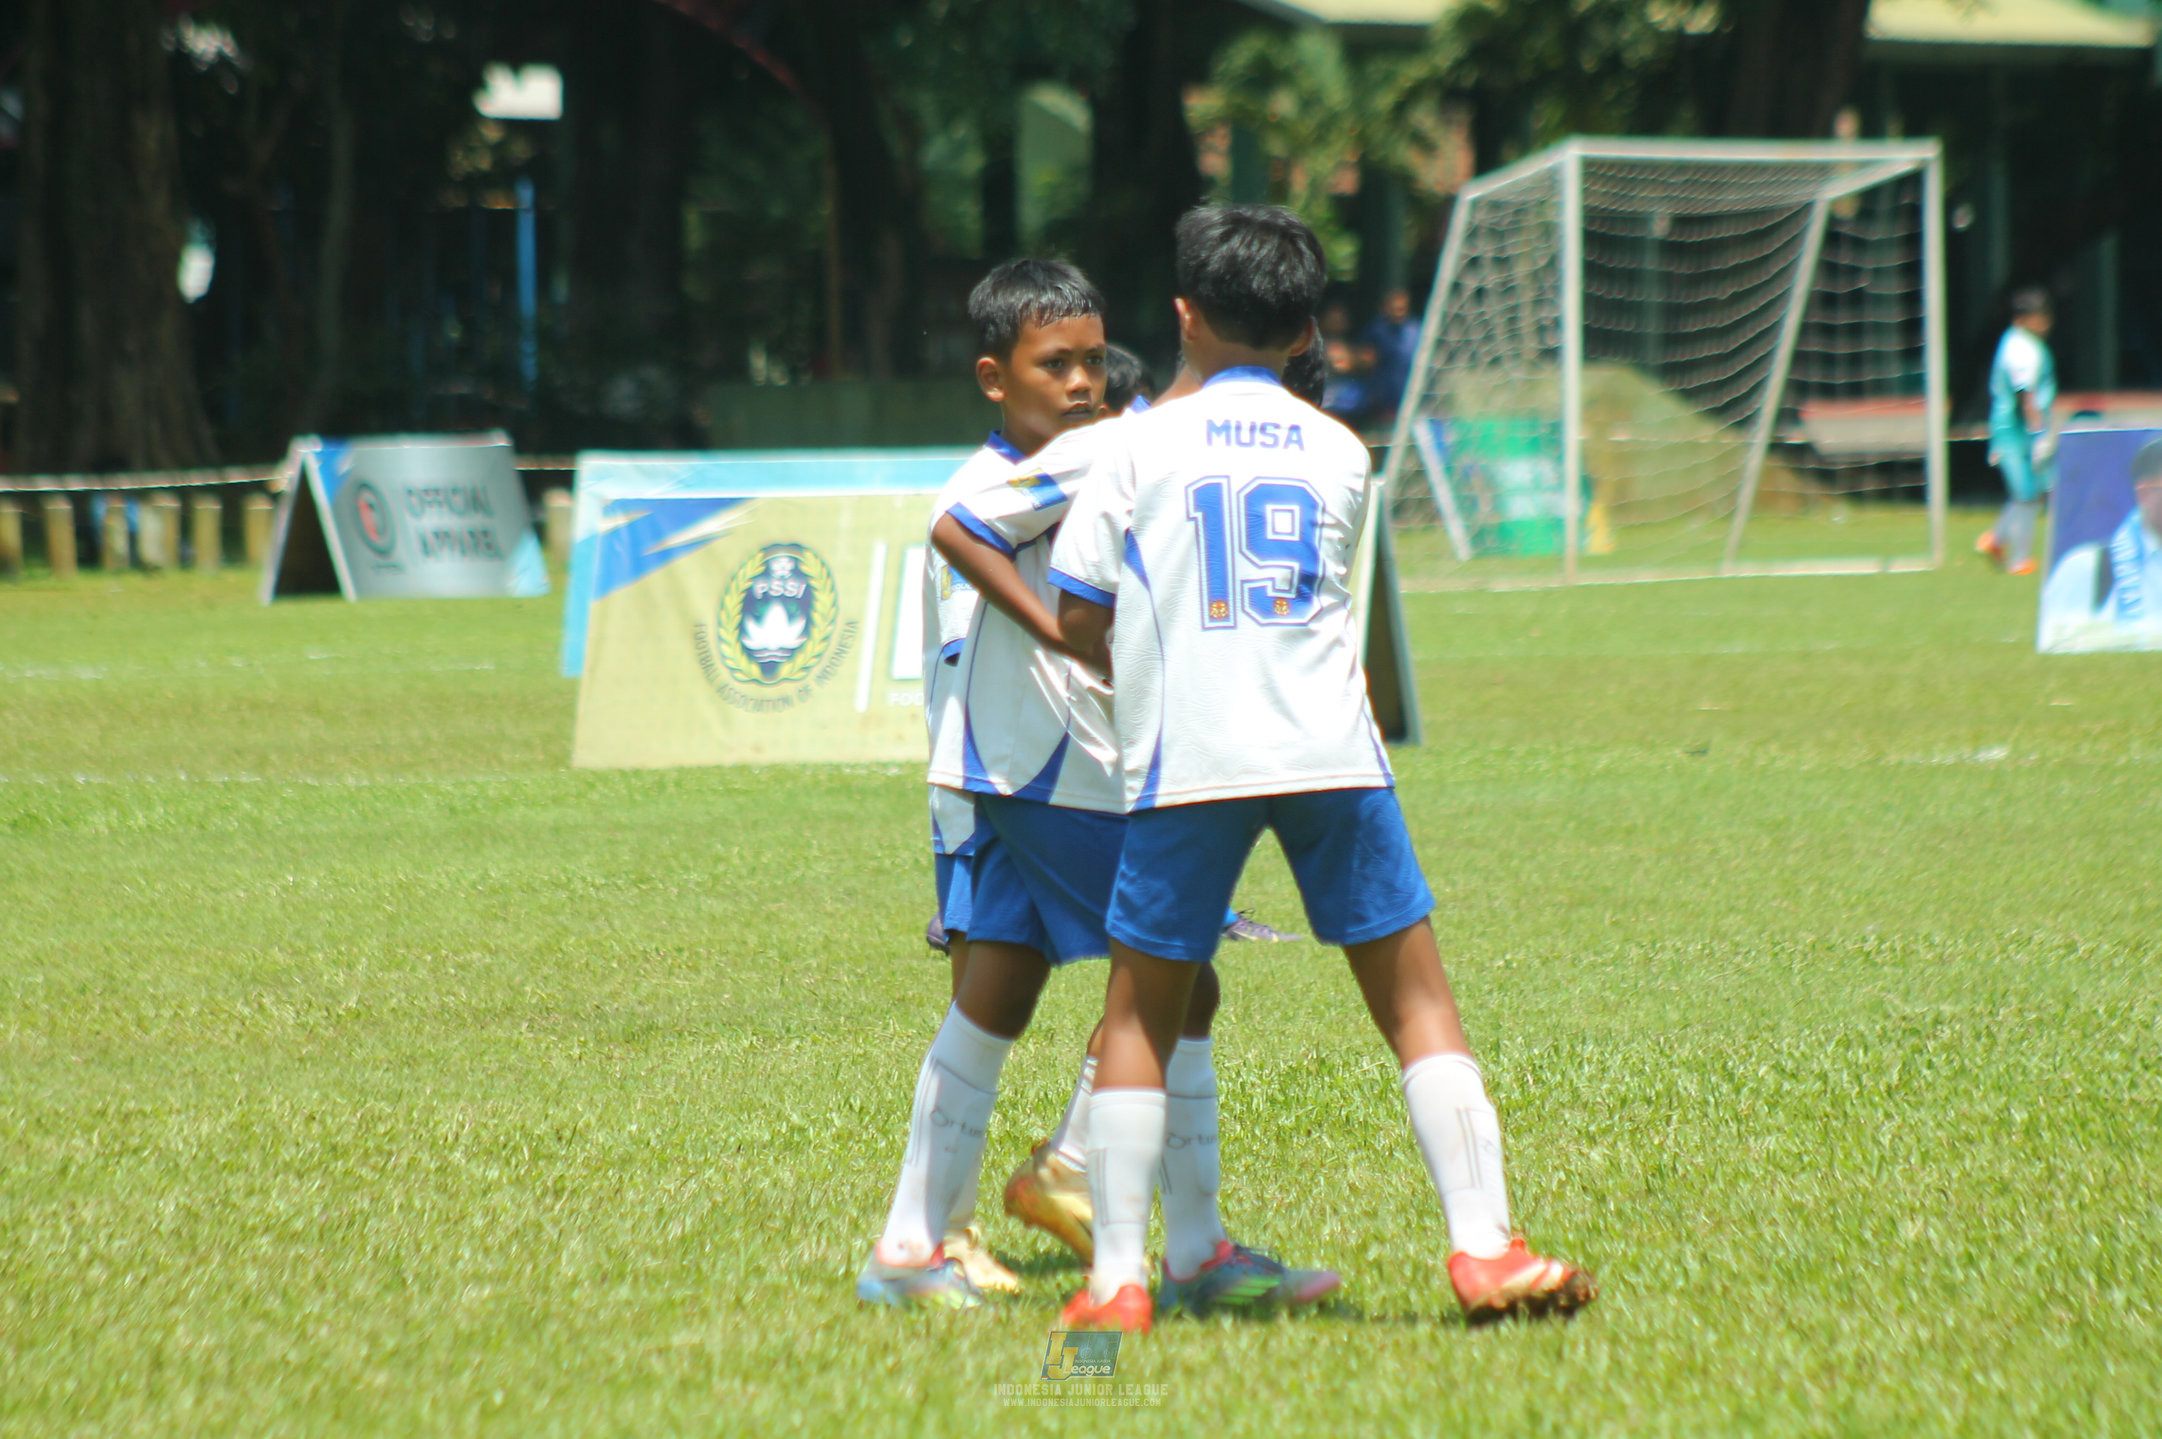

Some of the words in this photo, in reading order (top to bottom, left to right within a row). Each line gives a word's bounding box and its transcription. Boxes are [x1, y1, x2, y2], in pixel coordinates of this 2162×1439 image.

[1205, 418, 1305, 451] MUSA
[1185, 476, 1326, 631] 19
[754, 580, 806, 599] PSSI
